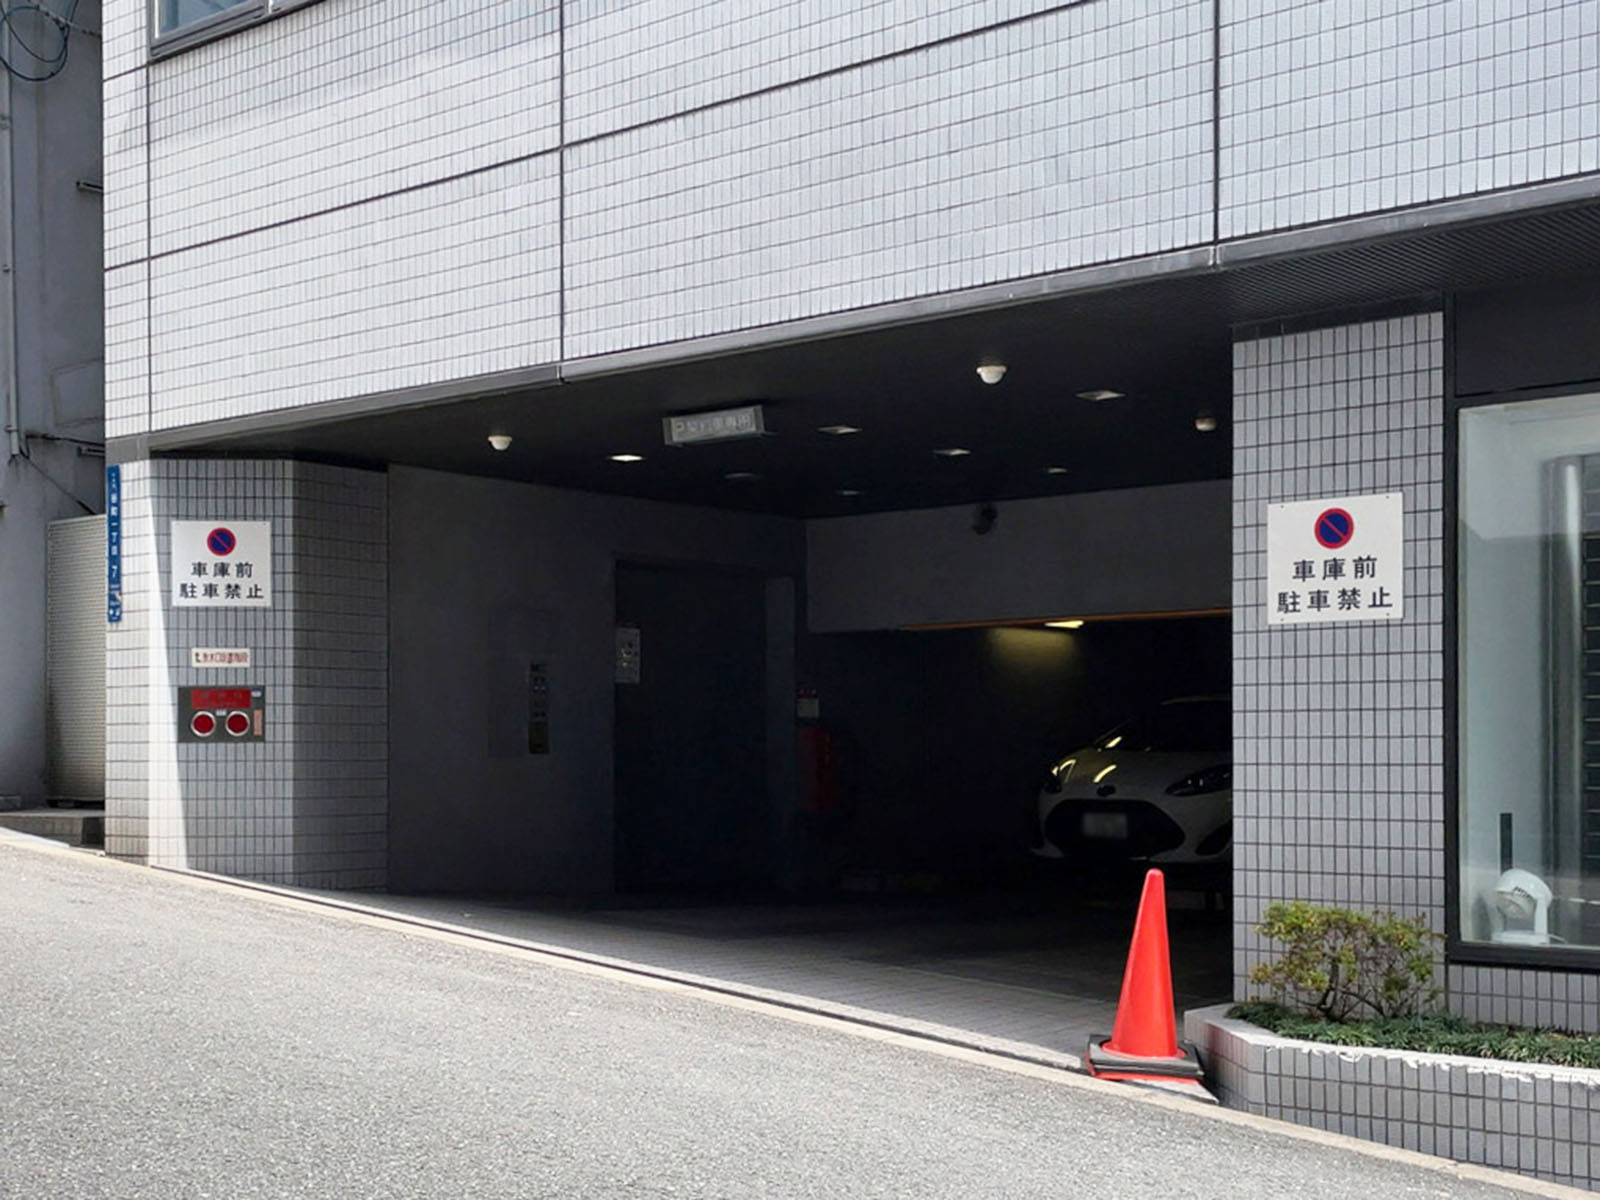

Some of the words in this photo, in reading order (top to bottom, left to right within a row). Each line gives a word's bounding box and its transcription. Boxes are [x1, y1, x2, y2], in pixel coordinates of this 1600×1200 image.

[191, 561, 254, 578] 車庫前
[1292, 555, 1378, 582] 車庫前
[179, 582, 264, 599] 駐車禁止
[1277, 586, 1393, 614] 駐車禁止
